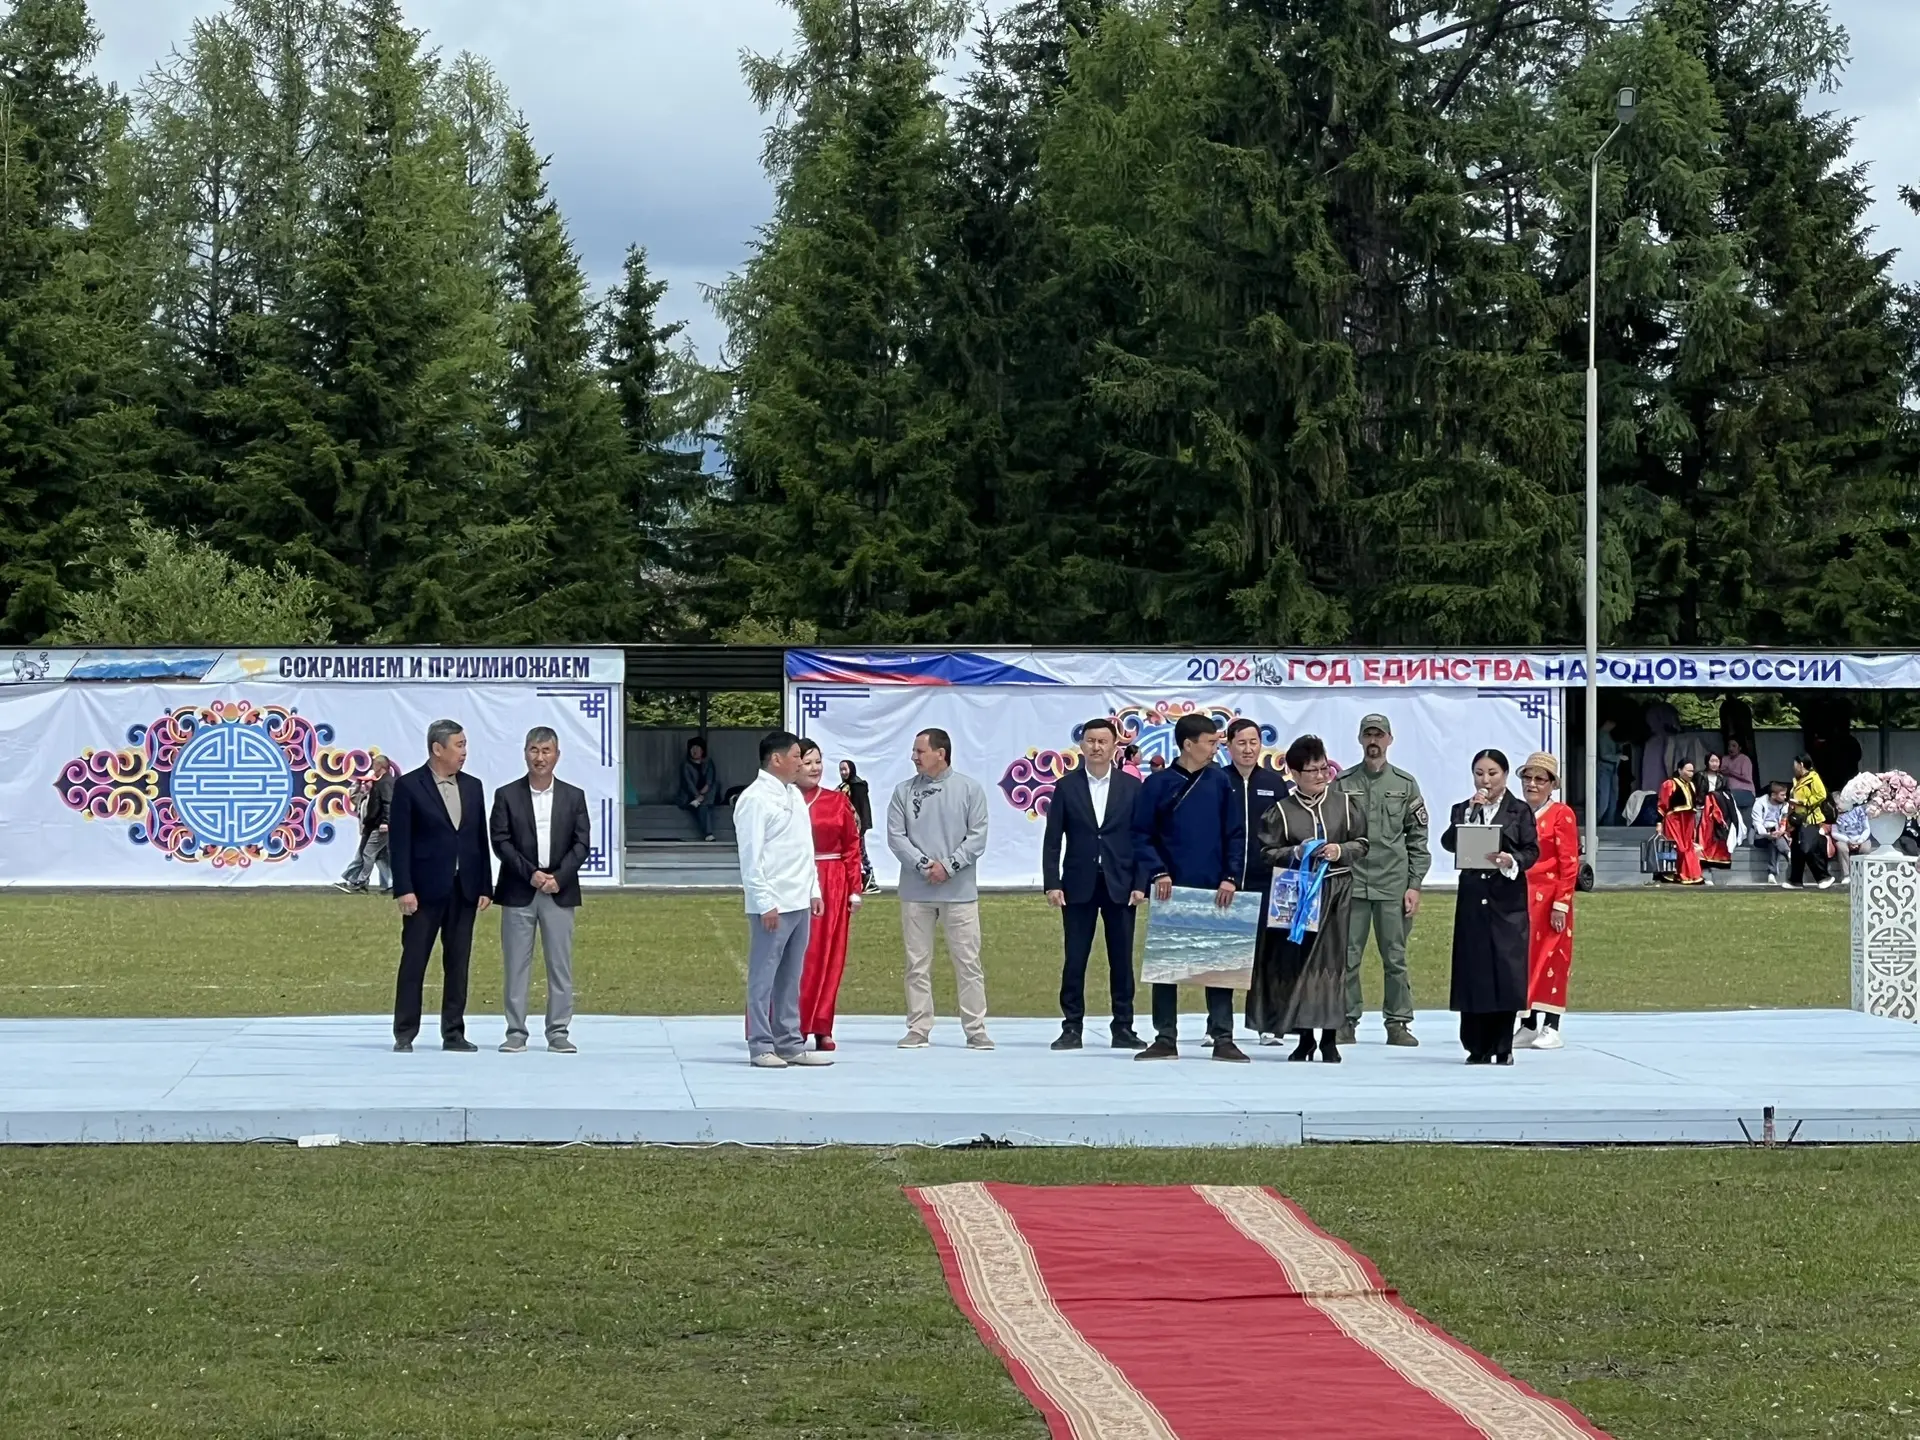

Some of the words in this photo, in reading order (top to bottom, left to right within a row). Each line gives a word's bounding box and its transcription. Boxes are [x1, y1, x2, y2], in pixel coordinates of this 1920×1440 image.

[279, 656, 404, 678] СОХРАНЯЕМ
[410, 656, 423, 678] И
[428, 656, 590, 678] ПРИУМНОЖАЕМ
[1187, 658, 1250, 681] 2026
[1288, 659, 1351, 685] ГОД
[1363, 659, 1534, 685] ЕДИНСТВА
[1709, 659, 1842, 681] РОССИИ
